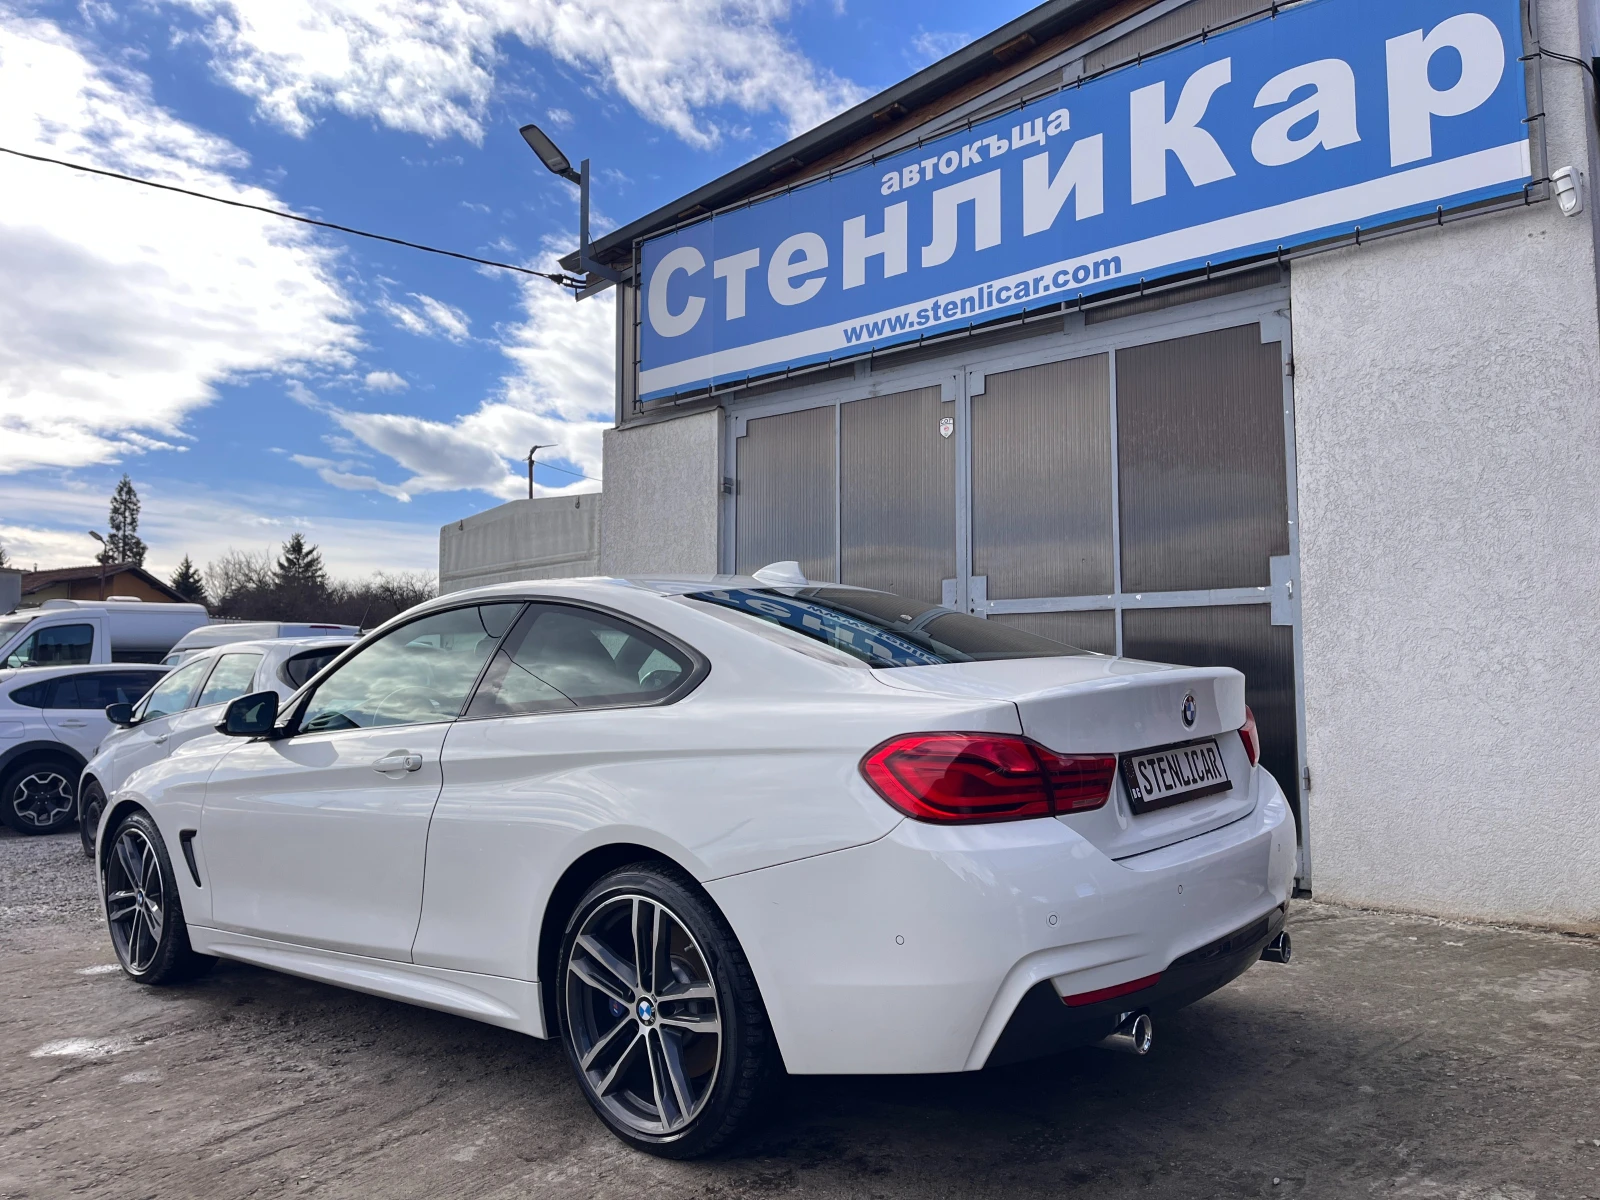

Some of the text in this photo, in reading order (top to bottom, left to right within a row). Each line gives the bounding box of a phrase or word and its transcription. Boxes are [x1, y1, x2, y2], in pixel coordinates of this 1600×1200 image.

[648, 13, 1505, 338] СтенлиКар
[881, 108, 1071, 196] автокъща
[843, 256, 1122, 344] www.stenlicar.com
[1139, 748, 1222, 795] STENLICAR
